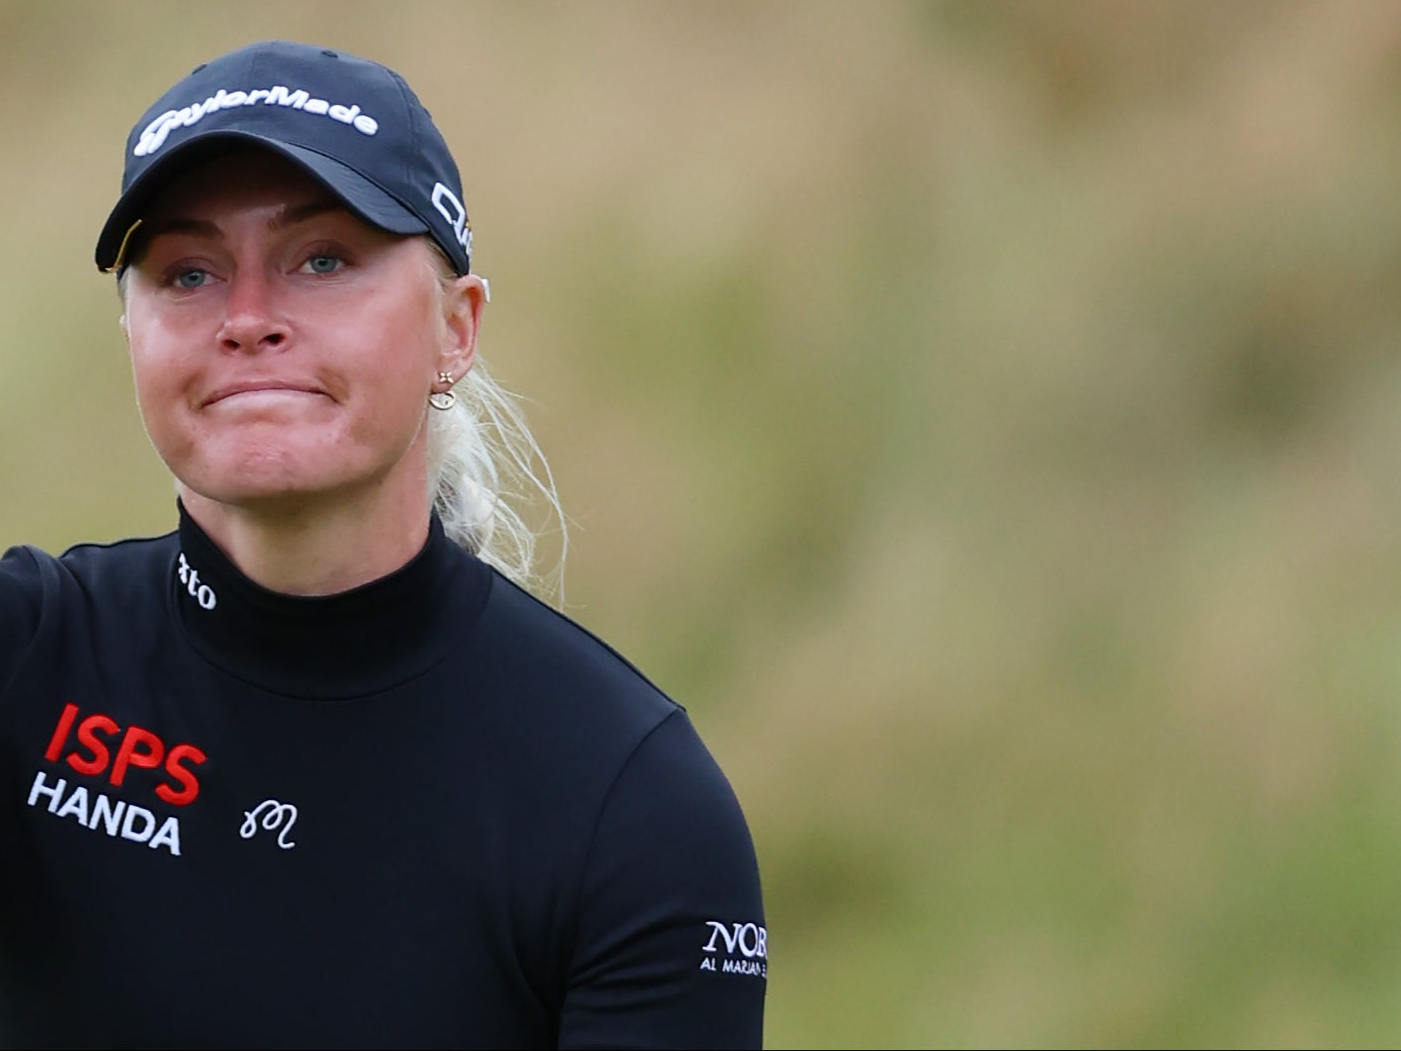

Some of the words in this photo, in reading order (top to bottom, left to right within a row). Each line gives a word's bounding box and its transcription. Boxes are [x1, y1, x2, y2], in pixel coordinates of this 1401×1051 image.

[133, 85, 379, 157] TaylorMade
[44, 701, 208, 807] ISPS
[27, 771, 182, 856] HANDA
